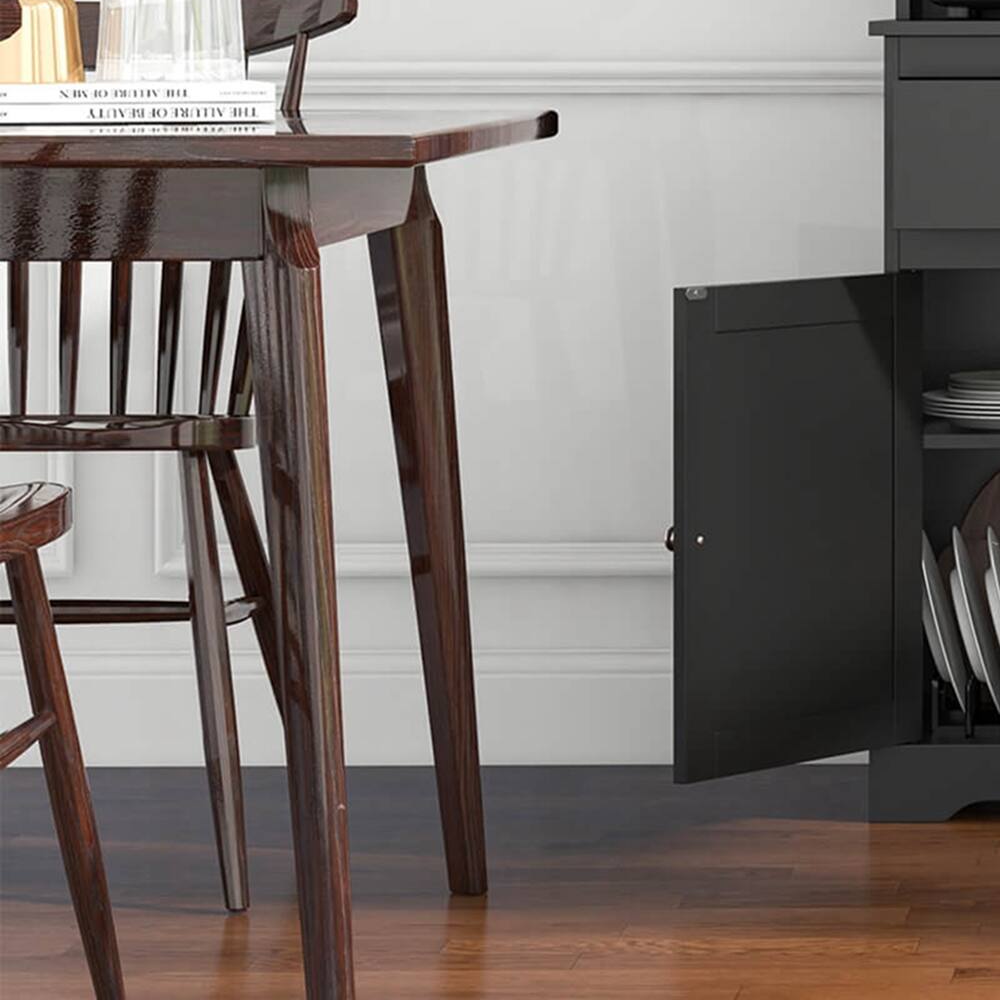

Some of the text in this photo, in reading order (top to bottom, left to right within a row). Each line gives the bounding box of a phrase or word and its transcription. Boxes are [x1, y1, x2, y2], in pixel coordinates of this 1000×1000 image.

[59, 89, 188, 98] THE ALLURE OF MEN
[87, 107, 258, 119] THE ALLURE OF BEAUTY
